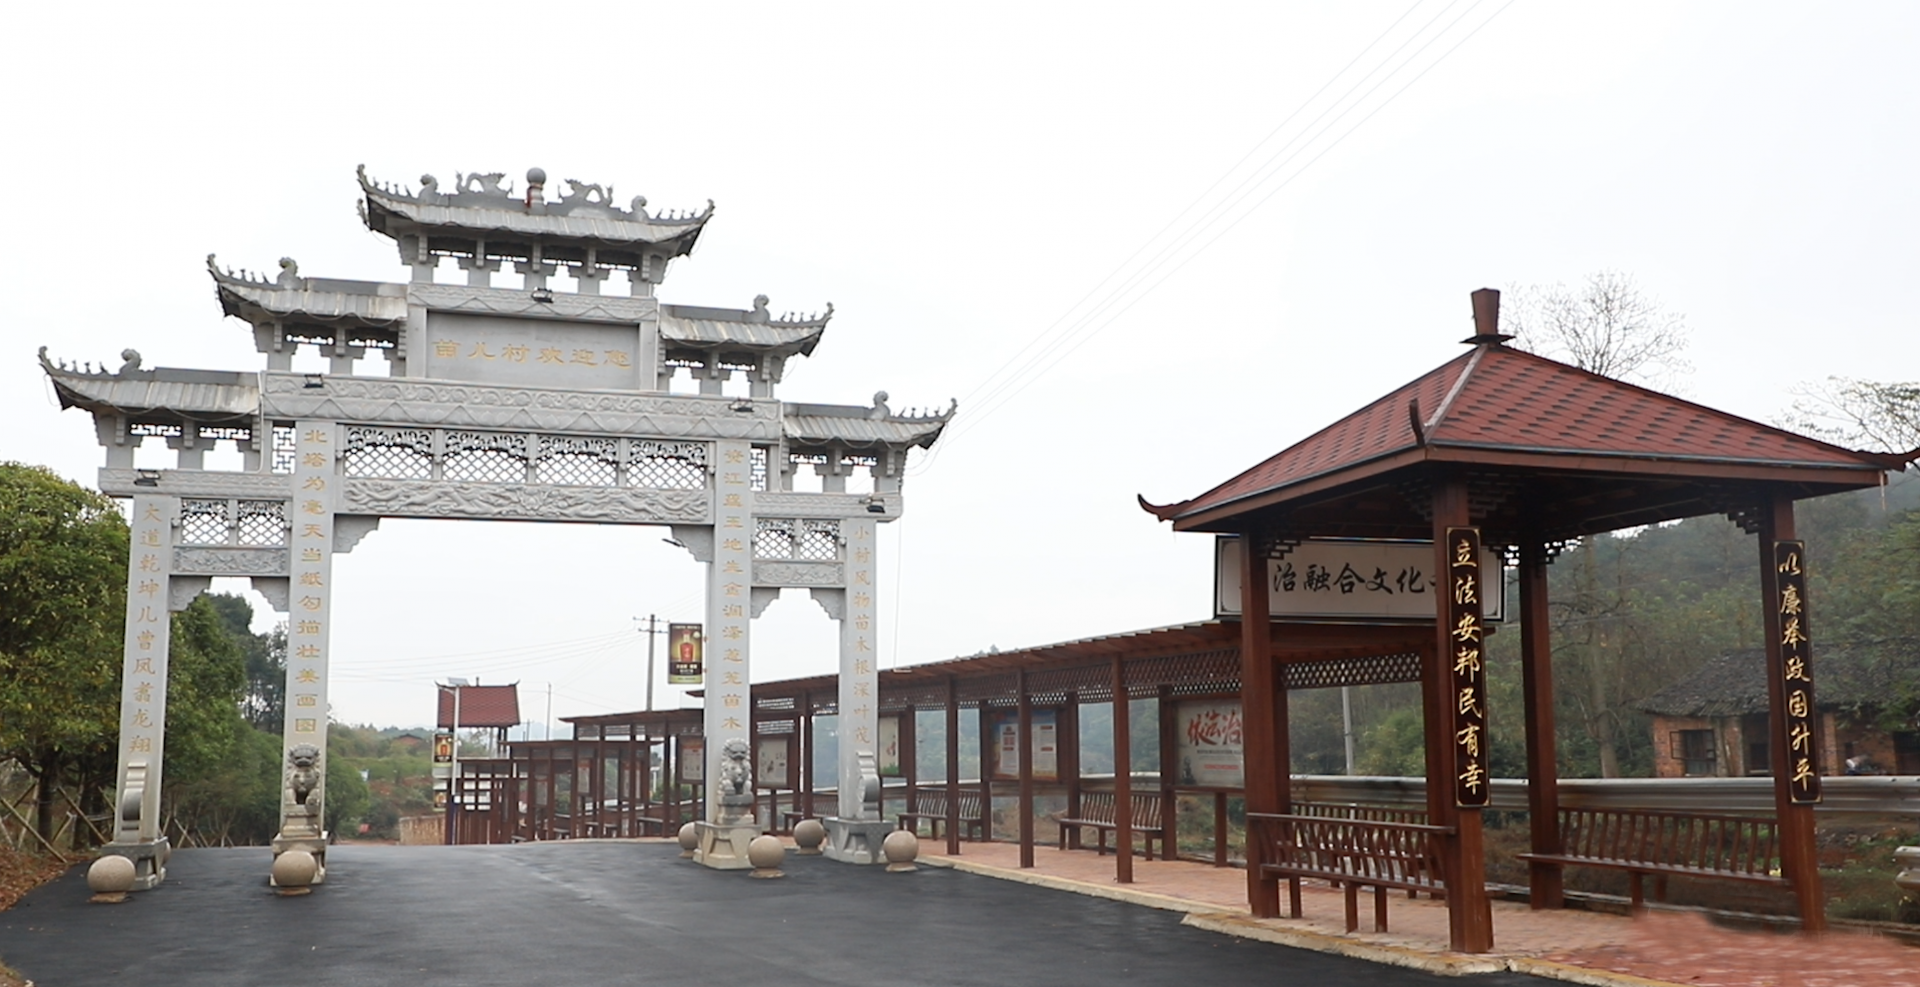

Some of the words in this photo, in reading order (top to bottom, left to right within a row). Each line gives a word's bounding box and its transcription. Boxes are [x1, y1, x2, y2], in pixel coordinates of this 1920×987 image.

[432, 339, 632, 370] 苗儿村欢迎您
[853, 526, 871, 744] 小村风物苗木根深叶茂
[1274, 562, 1437, 595] 治融合文化
[1452, 539, 1484, 795] 立法安邦民有幸
[1779, 552, 1814, 791] 以廉举政国升平
